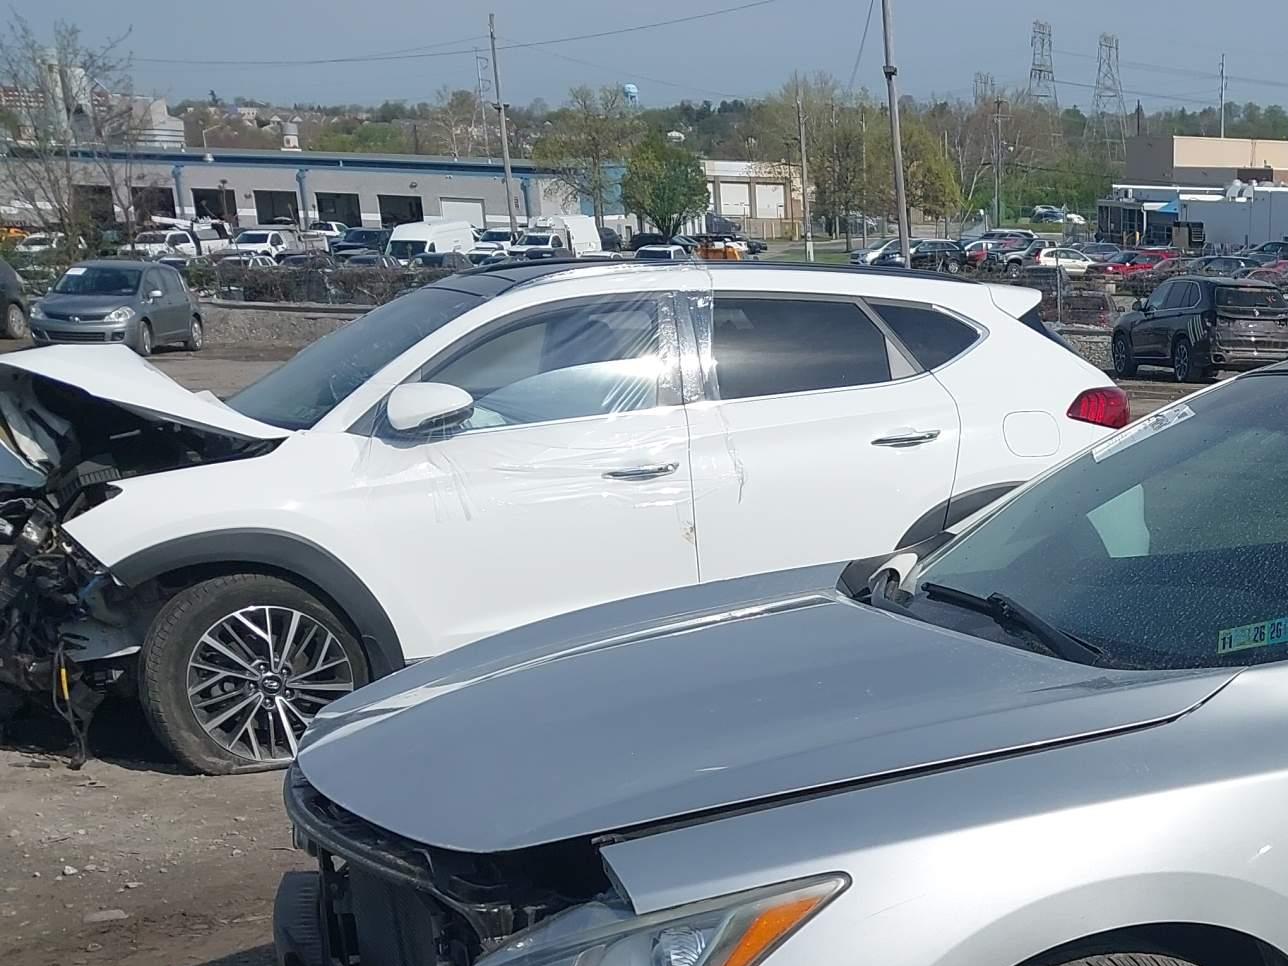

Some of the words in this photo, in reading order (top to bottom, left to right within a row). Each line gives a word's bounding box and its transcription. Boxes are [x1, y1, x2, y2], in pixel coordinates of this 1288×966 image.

[1221, 635, 1233, 650] 11
[1254, 625, 1266, 642] 26
[1270, 622, 1282, 640] 26
